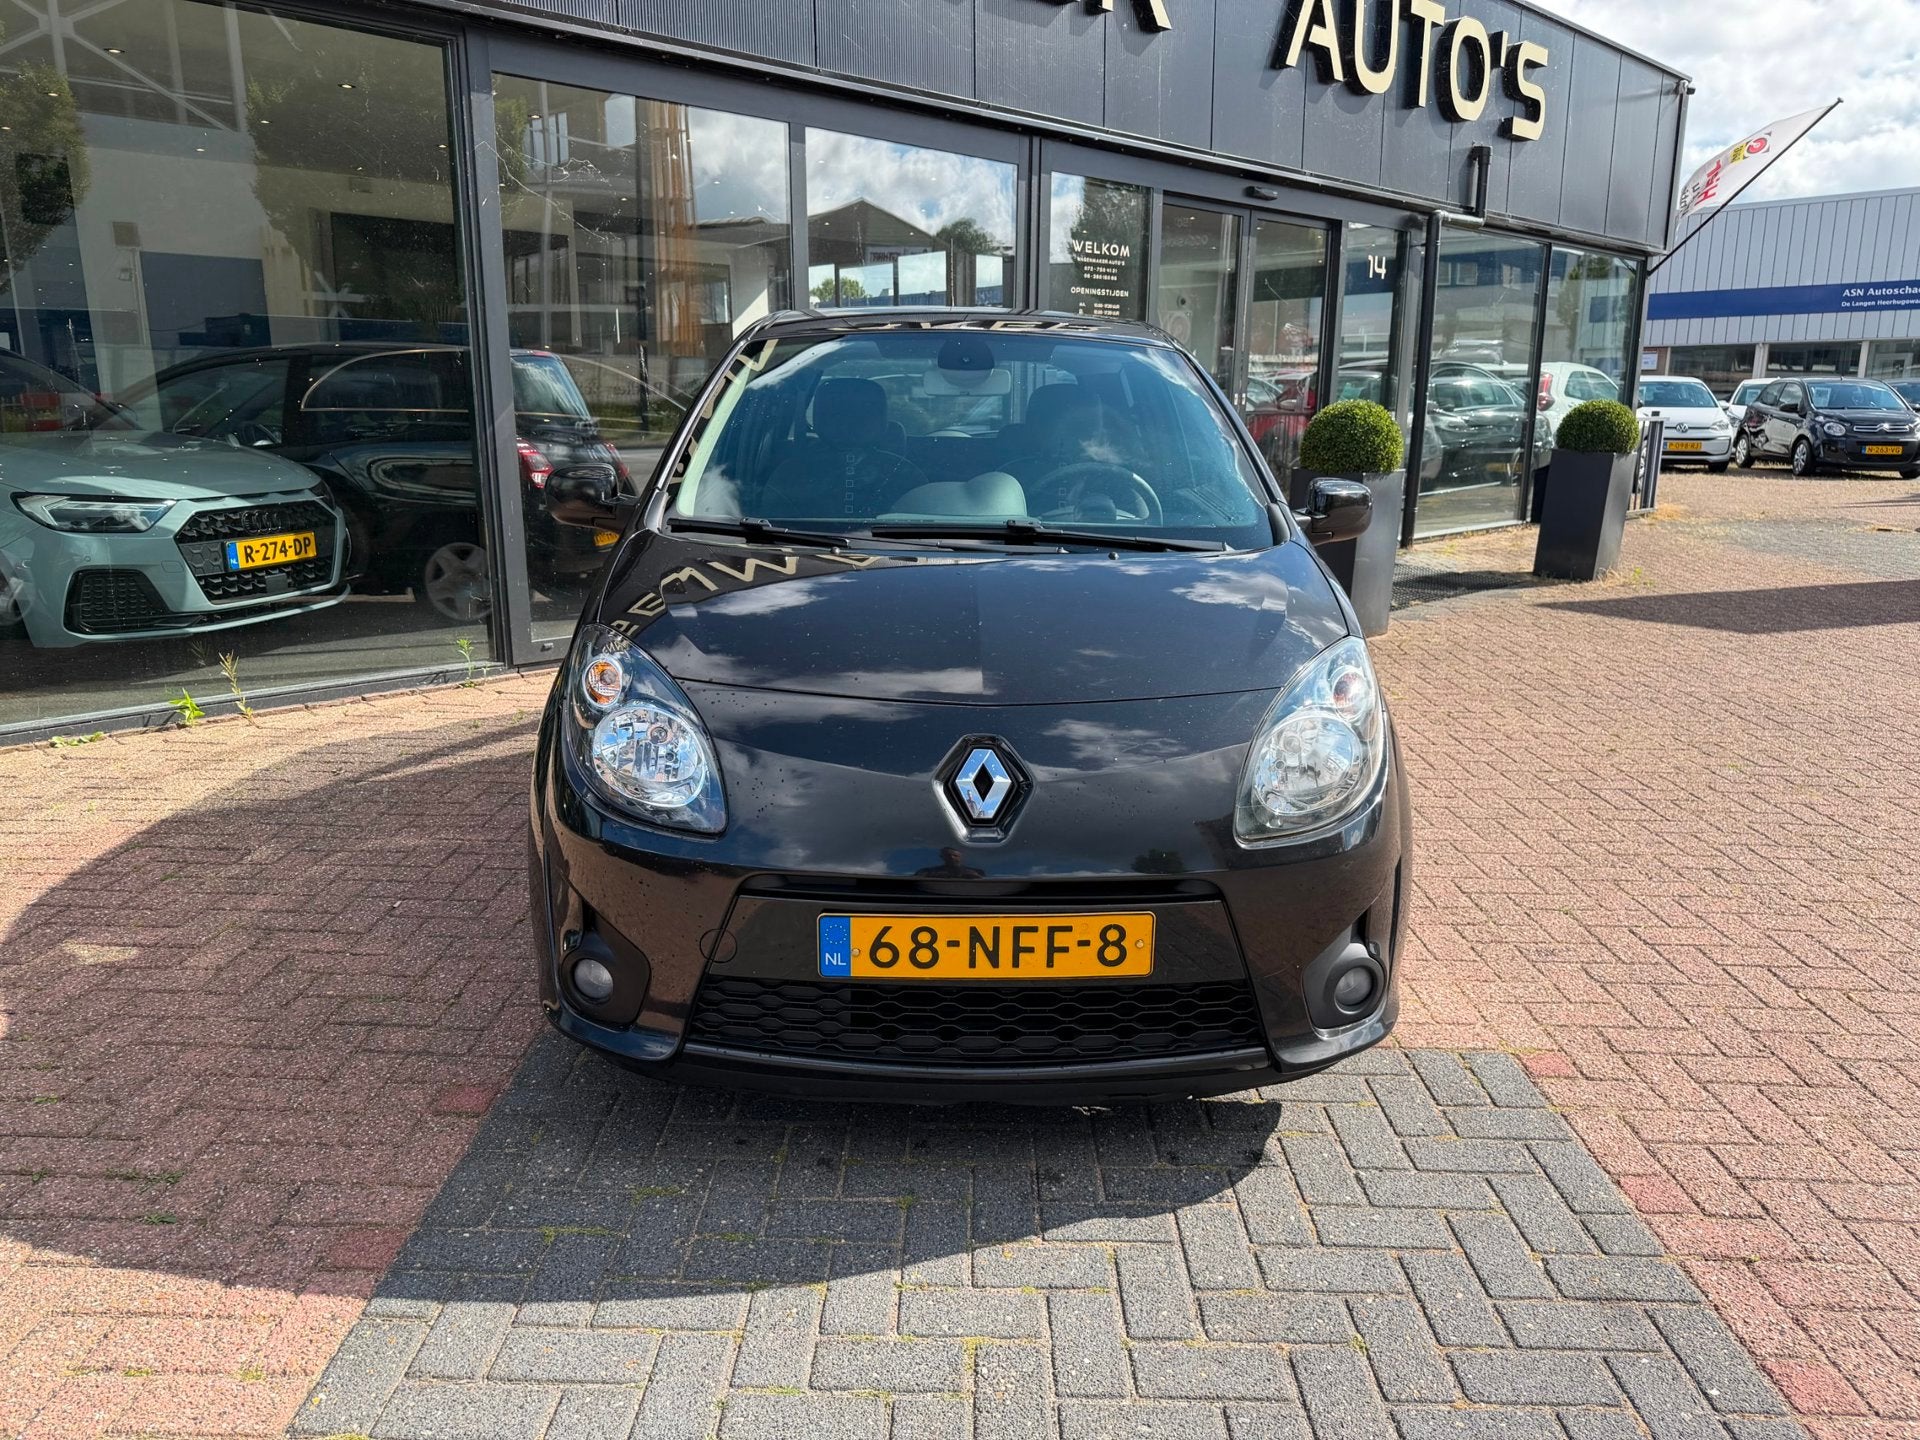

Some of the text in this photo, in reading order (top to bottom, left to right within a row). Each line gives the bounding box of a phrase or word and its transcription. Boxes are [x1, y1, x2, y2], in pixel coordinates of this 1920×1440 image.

[1285, 0, 1549, 141] AUTO'S
[1072, 239, 1130, 257] WELKOM
[1368, 254, 1387, 280] 14
[1070, 286, 1129, 298] OPENINGSTIJDEN
[1842, 288, 1864, 297] ASN
[1877, 298, 1920, 306] Heerhugowa
[1867, 446, 1901, 454] N-263-VG
[243, 536, 312, 564] R-274-DP
[824, 923, 1128, 970] NL 68-NFF-8
